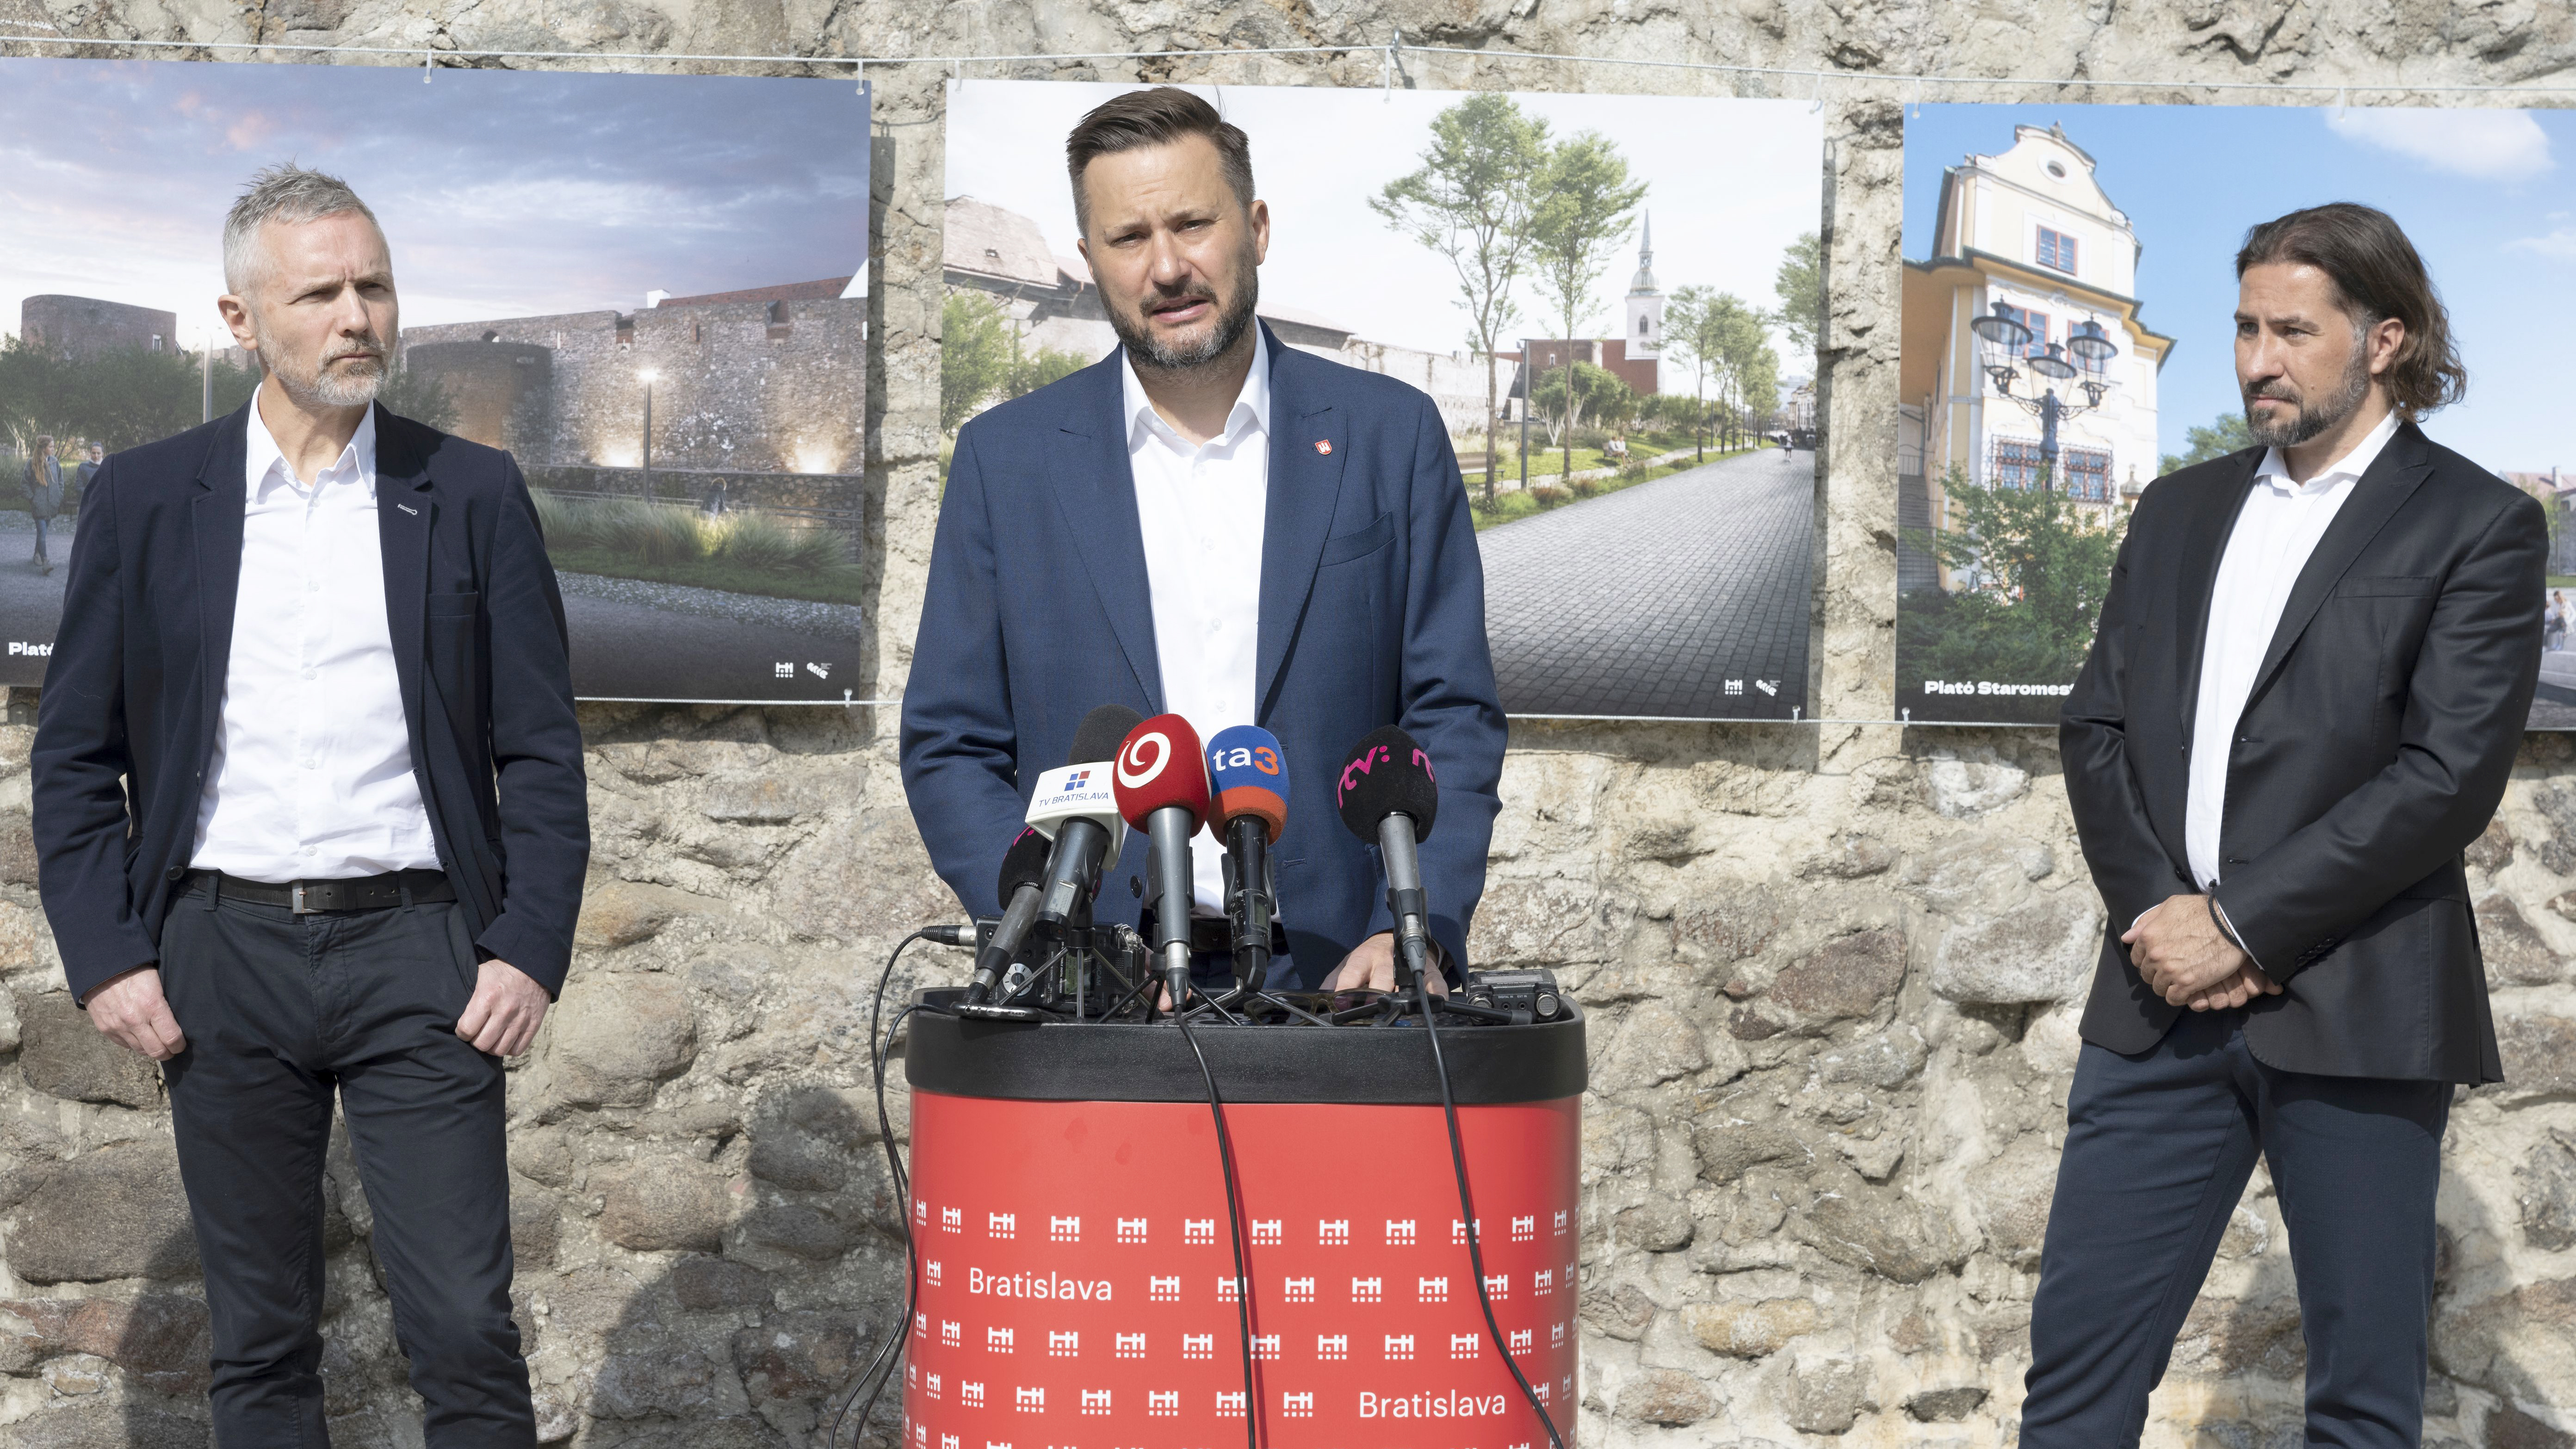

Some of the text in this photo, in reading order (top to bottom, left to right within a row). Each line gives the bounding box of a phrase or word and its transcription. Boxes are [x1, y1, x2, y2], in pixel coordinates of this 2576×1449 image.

[1925, 680, 1975, 694] Plató
[1213, 746, 1280, 775] ta3
[1039, 792, 1109, 807] TV BRATISLAVA
[970, 1267, 1112, 1300] Bratislava
[1359, 1389, 1505, 1418] Bratislava
